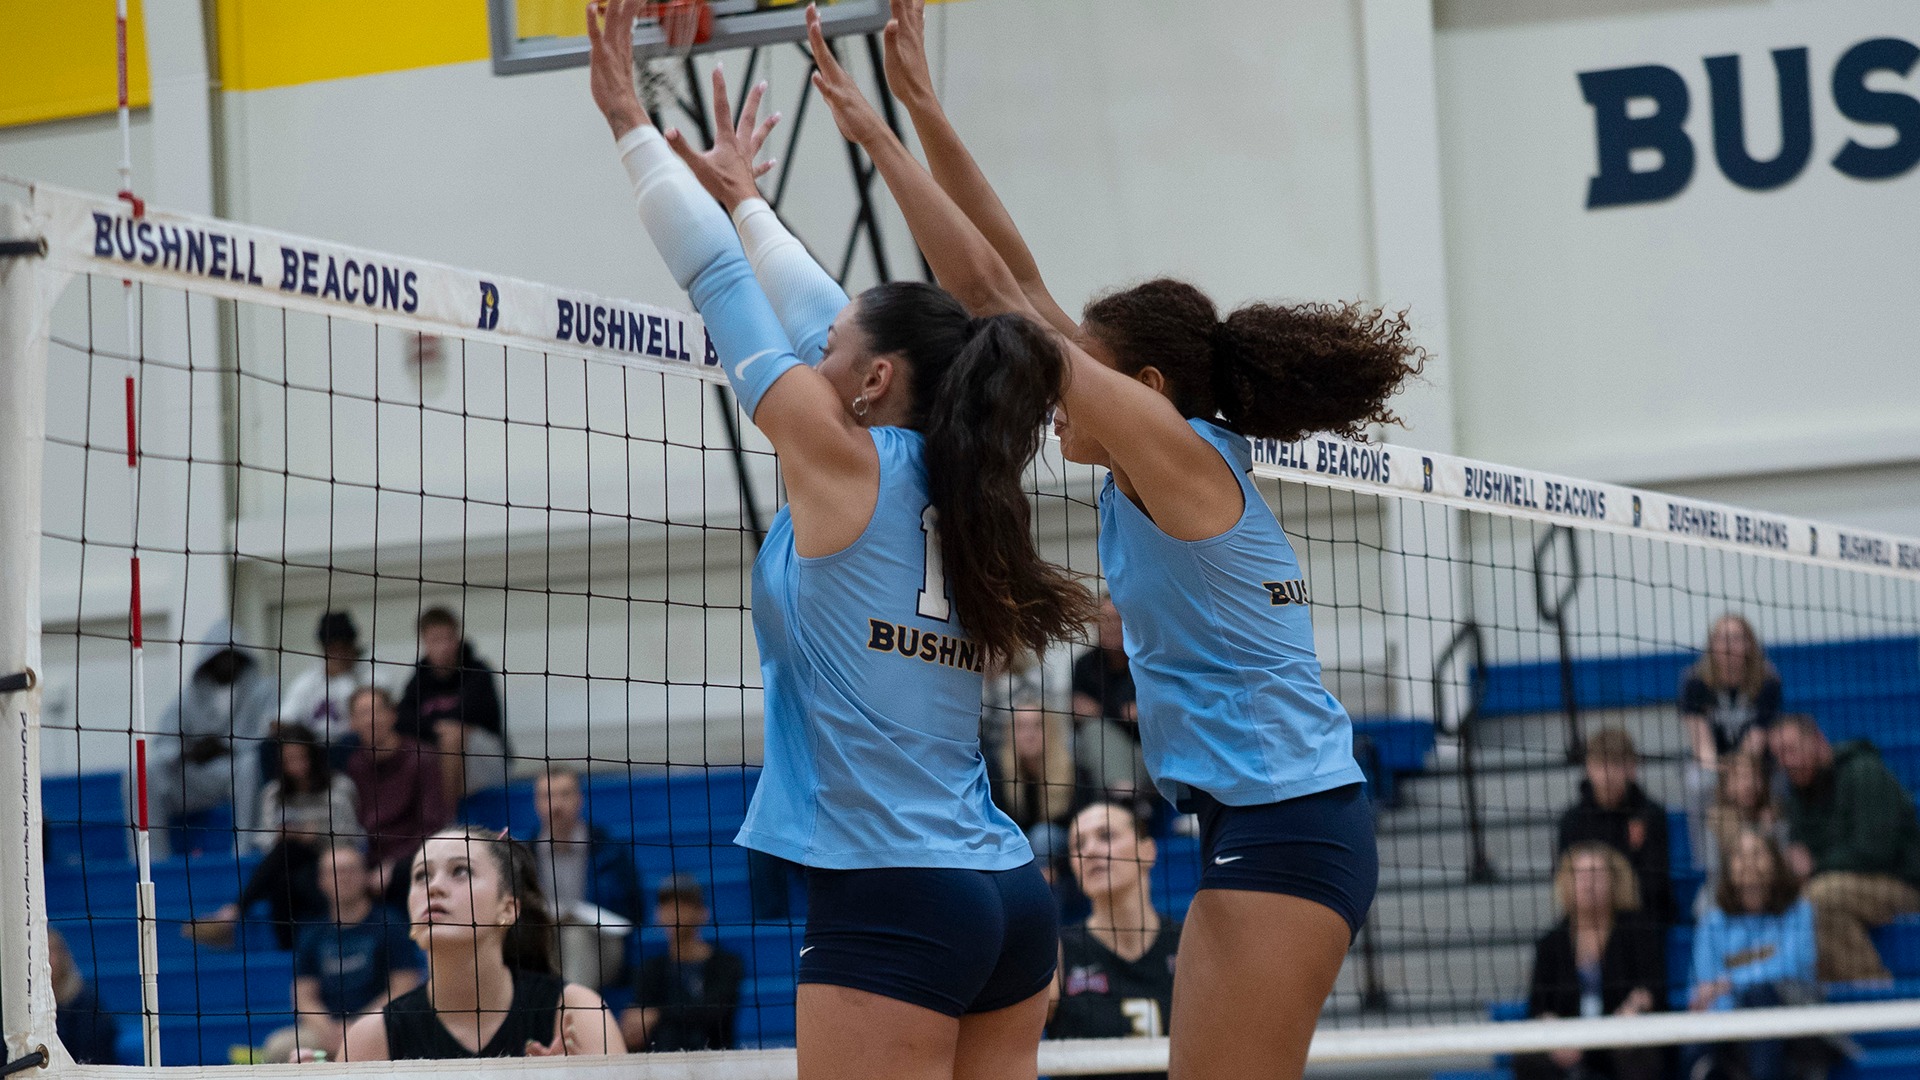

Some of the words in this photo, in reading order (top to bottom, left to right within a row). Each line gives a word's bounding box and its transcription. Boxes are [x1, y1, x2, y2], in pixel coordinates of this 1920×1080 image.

[1575, 37, 1920, 211] BUS
[92, 211, 263, 286] BUSHNELL
[280, 247, 418, 314] BEACONS
[556, 298, 691, 362] BUSHNELL
[1316, 440, 1391, 484] BEACONS
[1464, 466, 1539, 509] BUSHNELL
[1545, 481, 1606, 520] BEACONS
[1668, 503, 1730, 541] BUSHNELL
[1736, 515, 1788, 549] BEACONS
